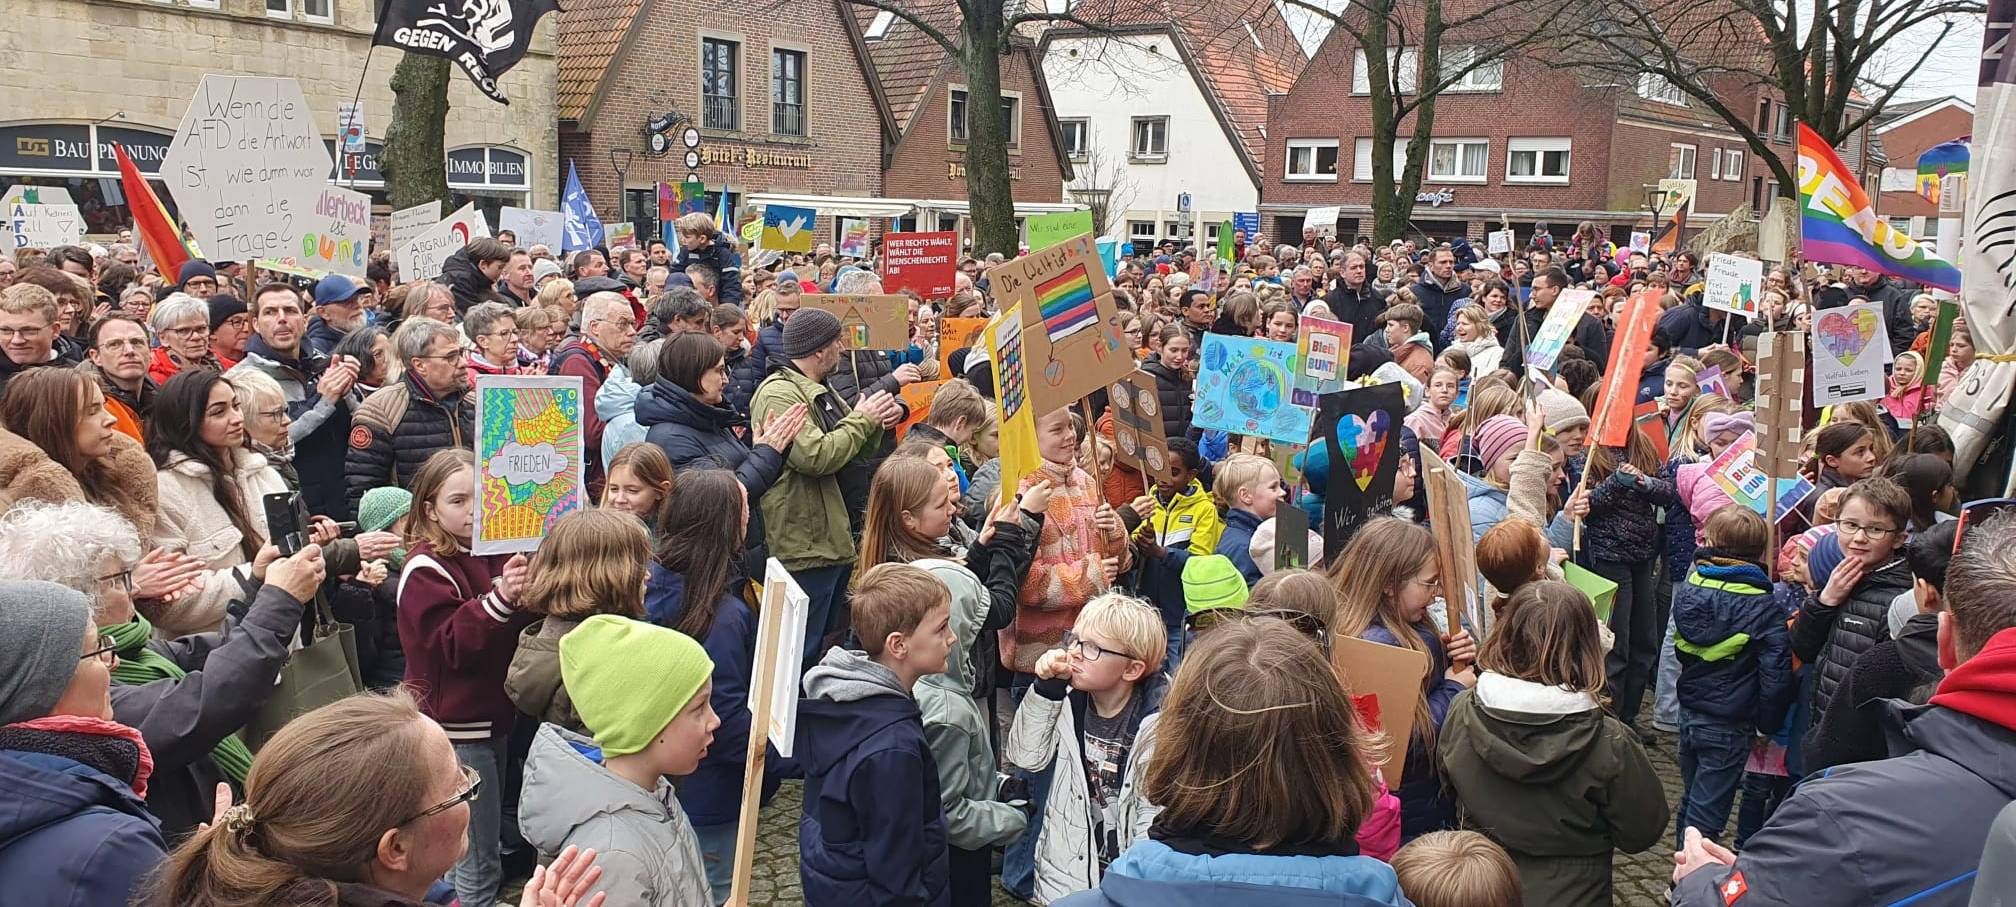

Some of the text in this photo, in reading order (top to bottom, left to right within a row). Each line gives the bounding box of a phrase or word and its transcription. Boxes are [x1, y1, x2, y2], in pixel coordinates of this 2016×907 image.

[393, 27, 505, 100] GEGEN REC
[205, 79, 263, 120] Wenn
[267, 82, 295, 120] die
[184, 117, 311, 150] AFD die Antwort
[226, 165, 253, 185] wie
[258, 156, 289, 183] dumm
[214, 184, 290, 219] dann die
[14, 220, 43, 234] Fall
[215, 213, 293, 259] Frage?
[410, 230, 462, 257] ABGRUND
[889, 236, 953, 248] WER RECHTS WÄHLT,
[889, 248, 924, 257] WÄHLT DIE
[889, 255, 948, 266] MENSCHENRECHTE
[1000, 272, 1023, 294] Die
[1023, 254, 1052, 281] Welt
[1308, 357, 1335, 374] BUNT!
[508, 453, 551, 473] FRIEDEN
[1743, 473, 1768, 495] BUN
[1334, 505, 1357, 530] Wir
